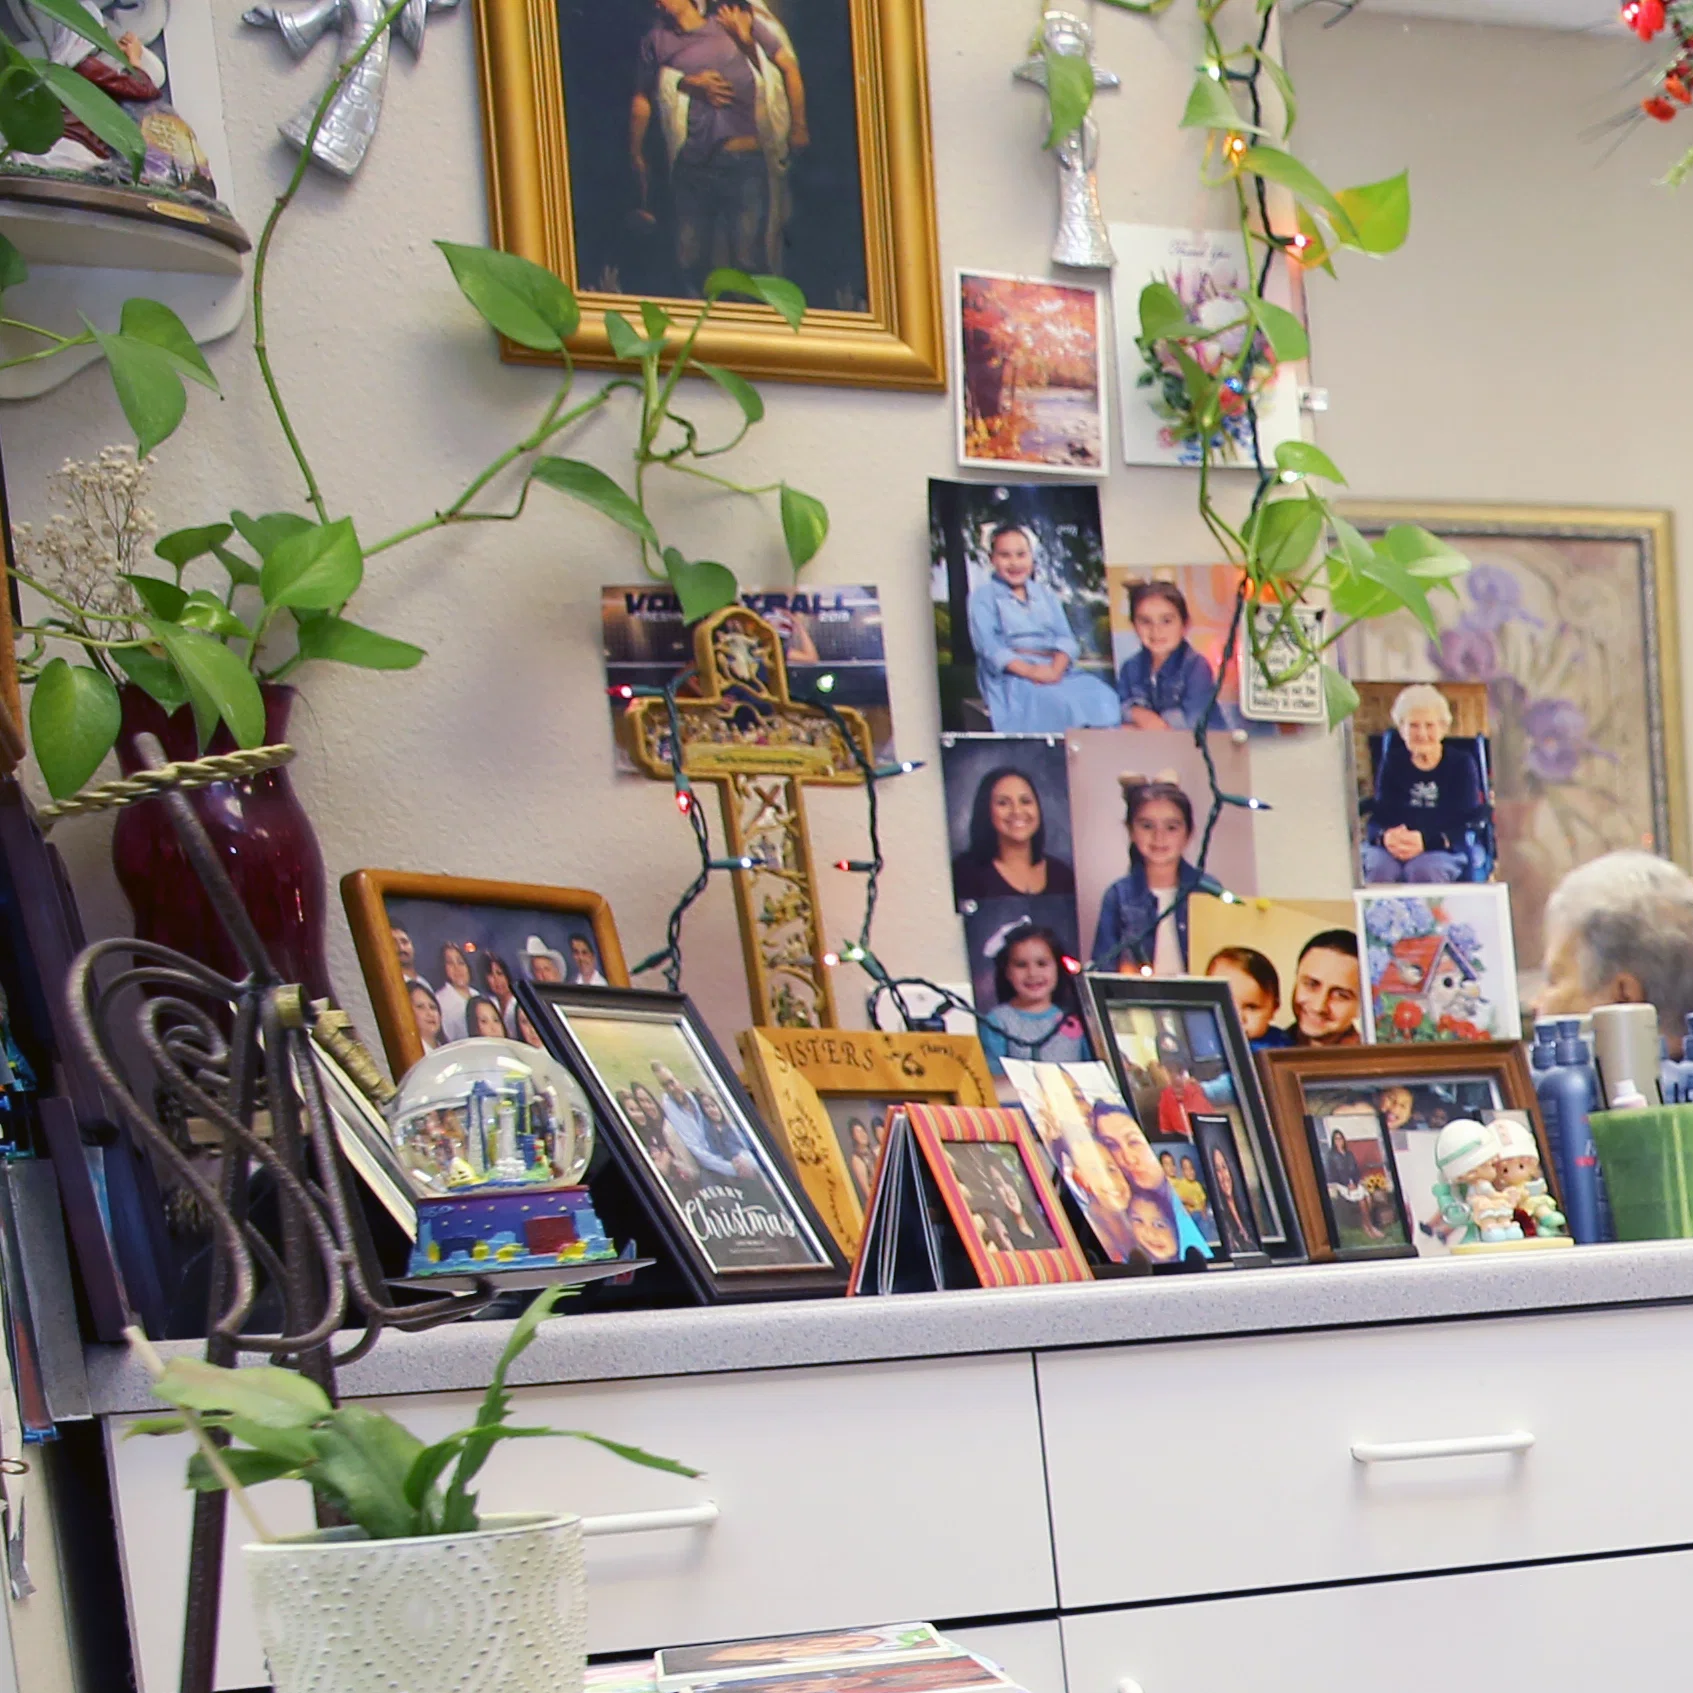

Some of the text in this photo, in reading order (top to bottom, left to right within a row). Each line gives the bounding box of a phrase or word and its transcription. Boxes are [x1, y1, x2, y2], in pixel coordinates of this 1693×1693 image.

[774, 1036, 875, 1073] SISTERS
[698, 1185, 744, 1201] MERRY
[684, 1197, 796, 1241] Christmas
